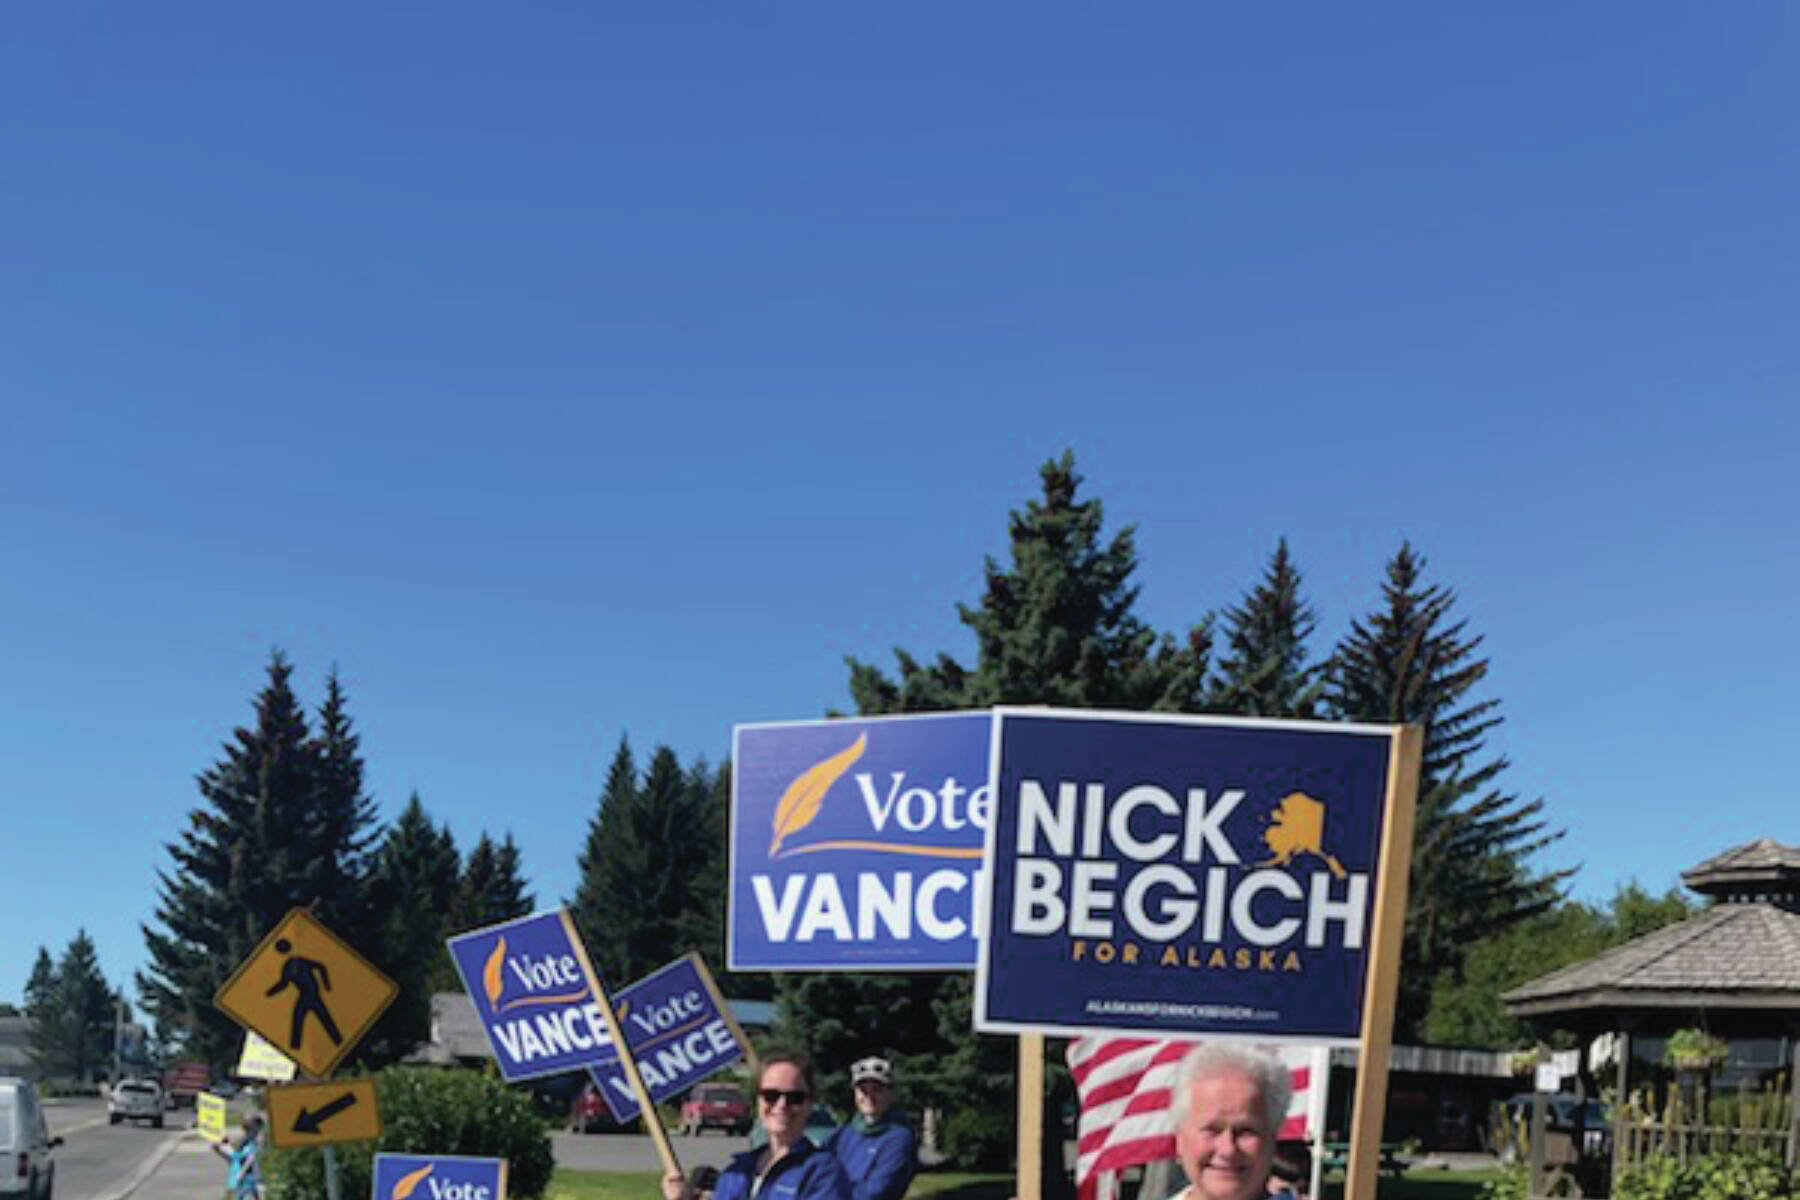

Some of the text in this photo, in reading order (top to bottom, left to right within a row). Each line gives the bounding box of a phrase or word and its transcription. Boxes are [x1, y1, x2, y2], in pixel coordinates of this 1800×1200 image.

[1016, 780, 1246, 864] NICK
[1012, 857, 1369, 949] BEGICH
[508, 954, 580, 992] Vote
[1073, 941, 1303, 973] FOR ALASKA
[492, 1003, 612, 1063] VANCE
[630, 990, 704, 1035] Vote
